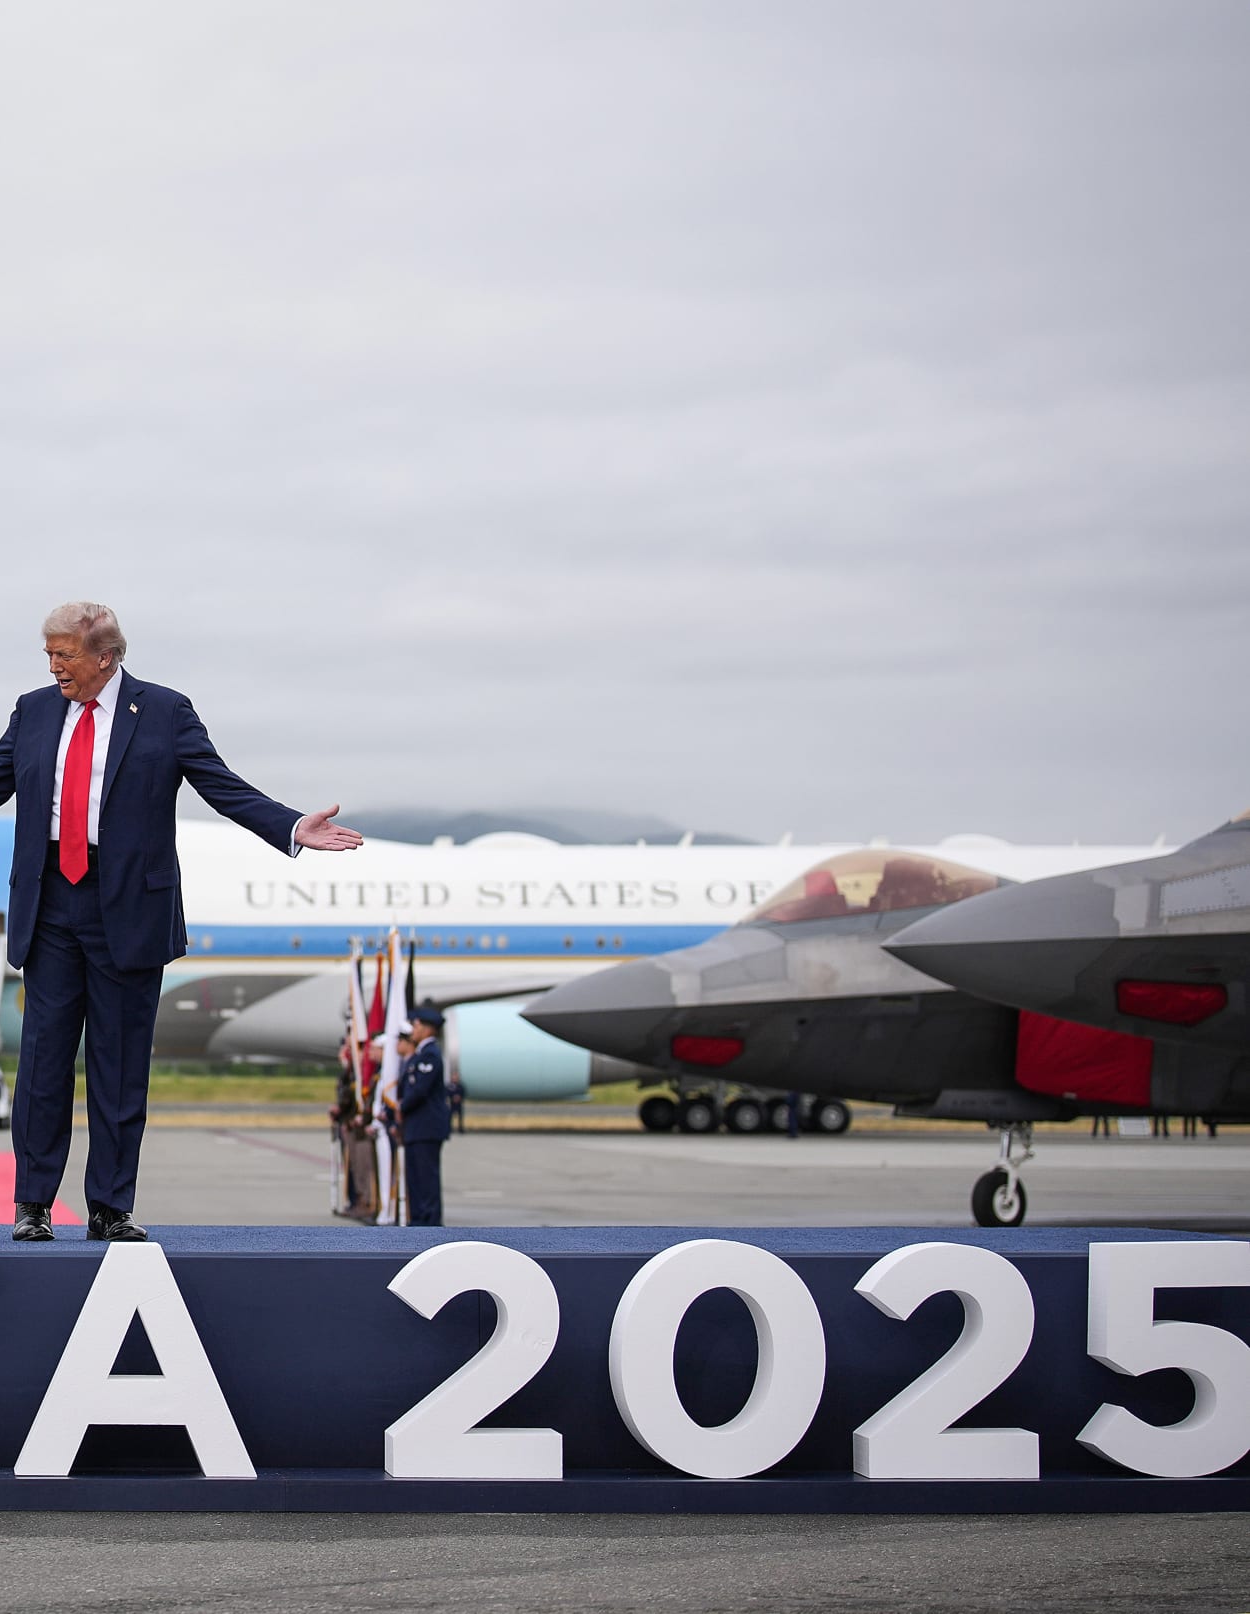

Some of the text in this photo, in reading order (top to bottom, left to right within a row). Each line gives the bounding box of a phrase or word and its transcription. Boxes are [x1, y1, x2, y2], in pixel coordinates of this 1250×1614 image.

[243, 880, 774, 910] UNITED STATES OF
[385, 1239, 1250, 1478] 2025
